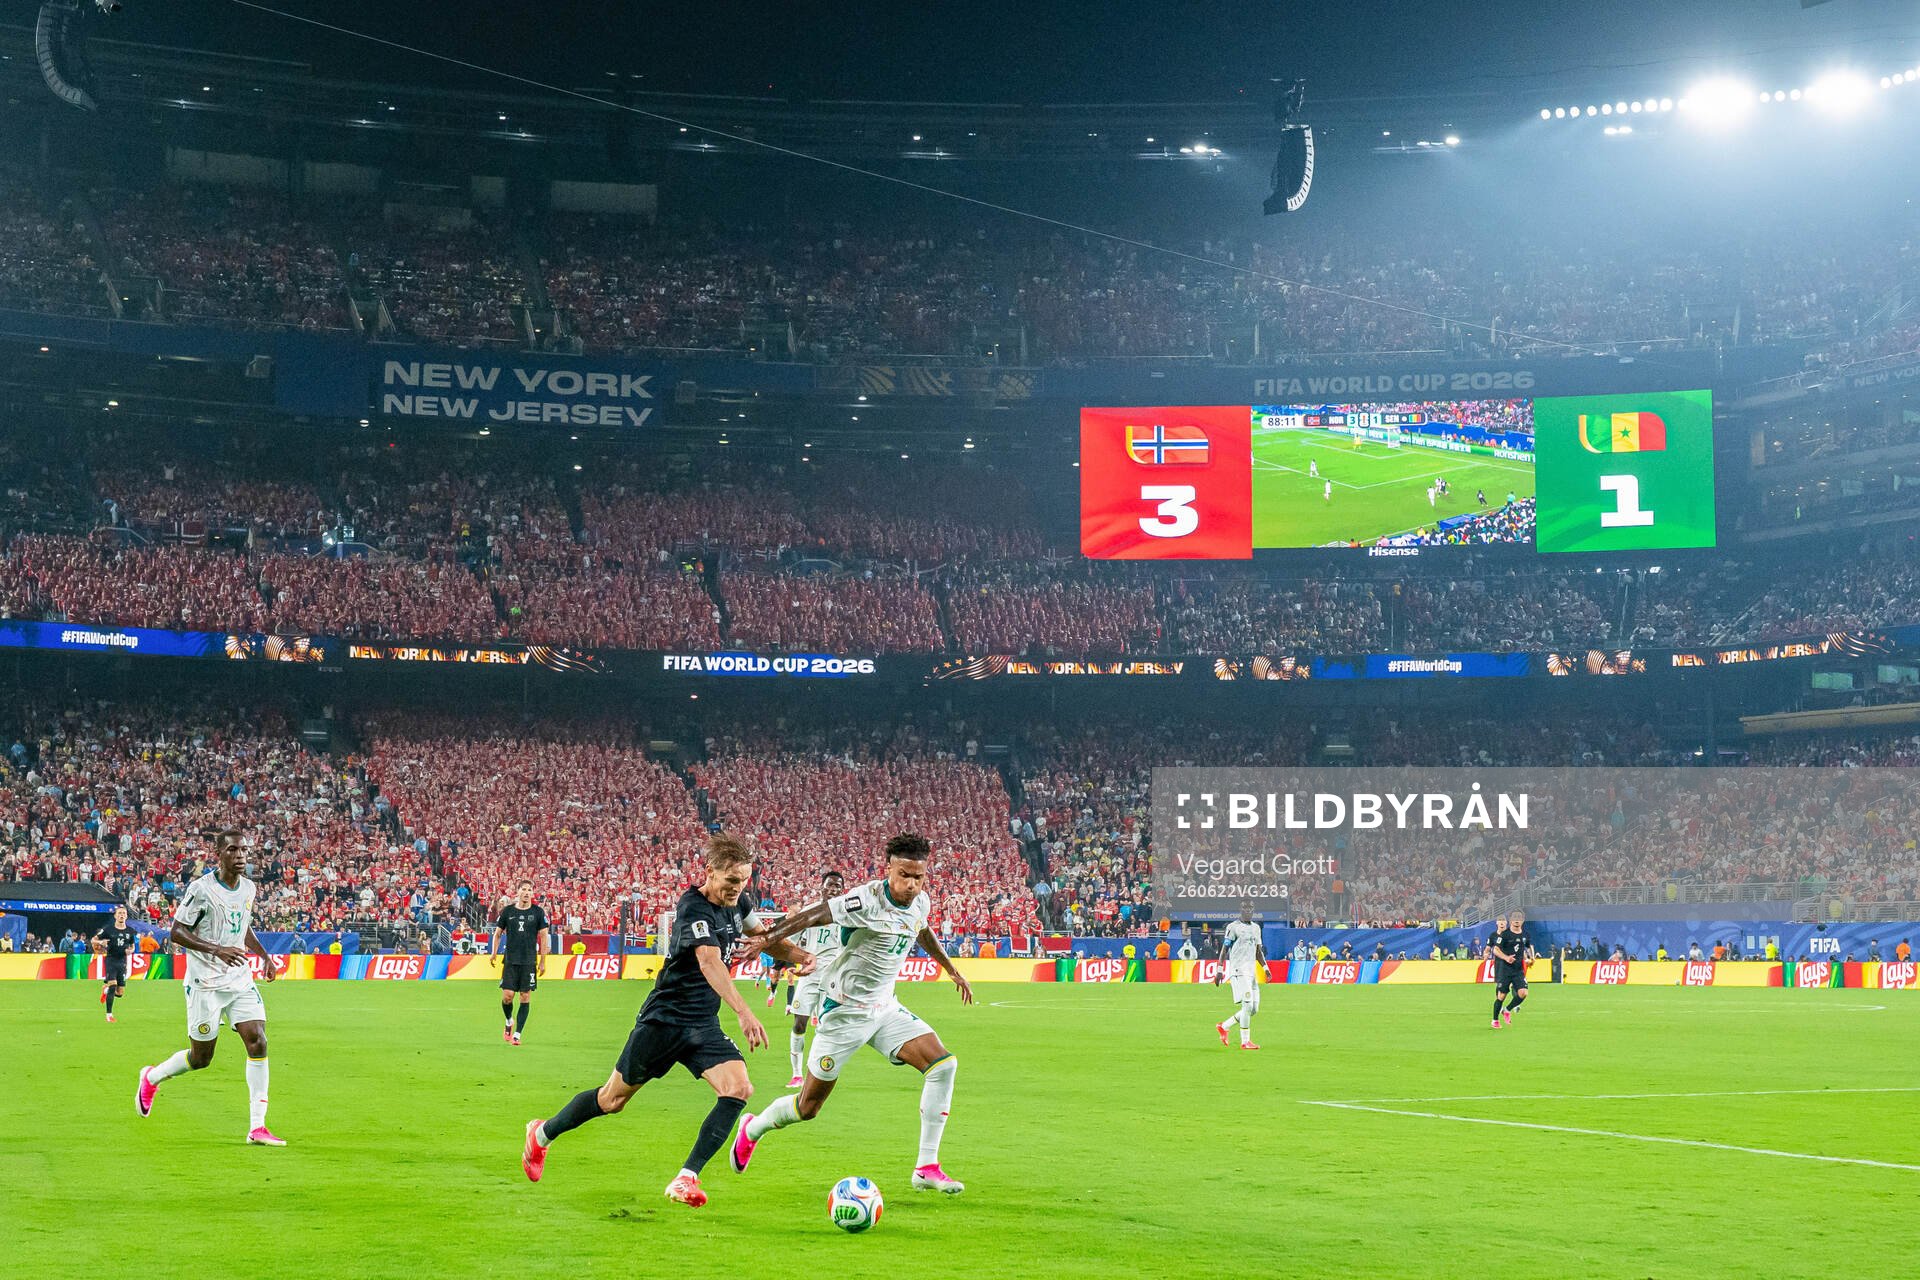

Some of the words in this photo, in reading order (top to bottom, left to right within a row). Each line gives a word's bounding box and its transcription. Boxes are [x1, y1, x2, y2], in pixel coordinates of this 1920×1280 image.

[384, 361, 500, 391] NEW
[512, 368, 653, 399] YORK
[1254, 379, 1303, 396] FIFA
[1308, 375, 1393, 396] WORLD
[1399, 374, 1446, 391] CUP
[1451, 371, 1536, 390] 2026
[383, 394, 479, 418] NEW
[489, 401, 653, 427] JERSEY
[1268, 417, 1296, 427] 88:11
[1385, 414, 1400, 423] SEN
[1138, 486, 1199, 537] 3
[1600, 475, 1654, 527] 1
[1368, 546, 1419, 556] Hisense
[62, 630, 138, 649] #FIFAWorldCup
[388, 647, 430, 661] YORK
[664, 655, 702, 671] FIFA
[704, 656, 770, 672] WORLD
[773, 657, 808, 673] CUP
[811, 658, 875, 673] 2026
[1388, 660, 1462, 673] #FIFAWorldCup
[817, 928, 831, 944] 17
[1810, 938, 1841, 954] FIFA
[373, 955, 419, 980] Lay's
[573, 955, 619, 980] Lay's
[898, 957, 938, 982] ay's
[1316, 961, 1354, 984] Lay's
[1595, 961, 1626, 984] Lay's
[1686, 961, 1713, 985] Lay's
